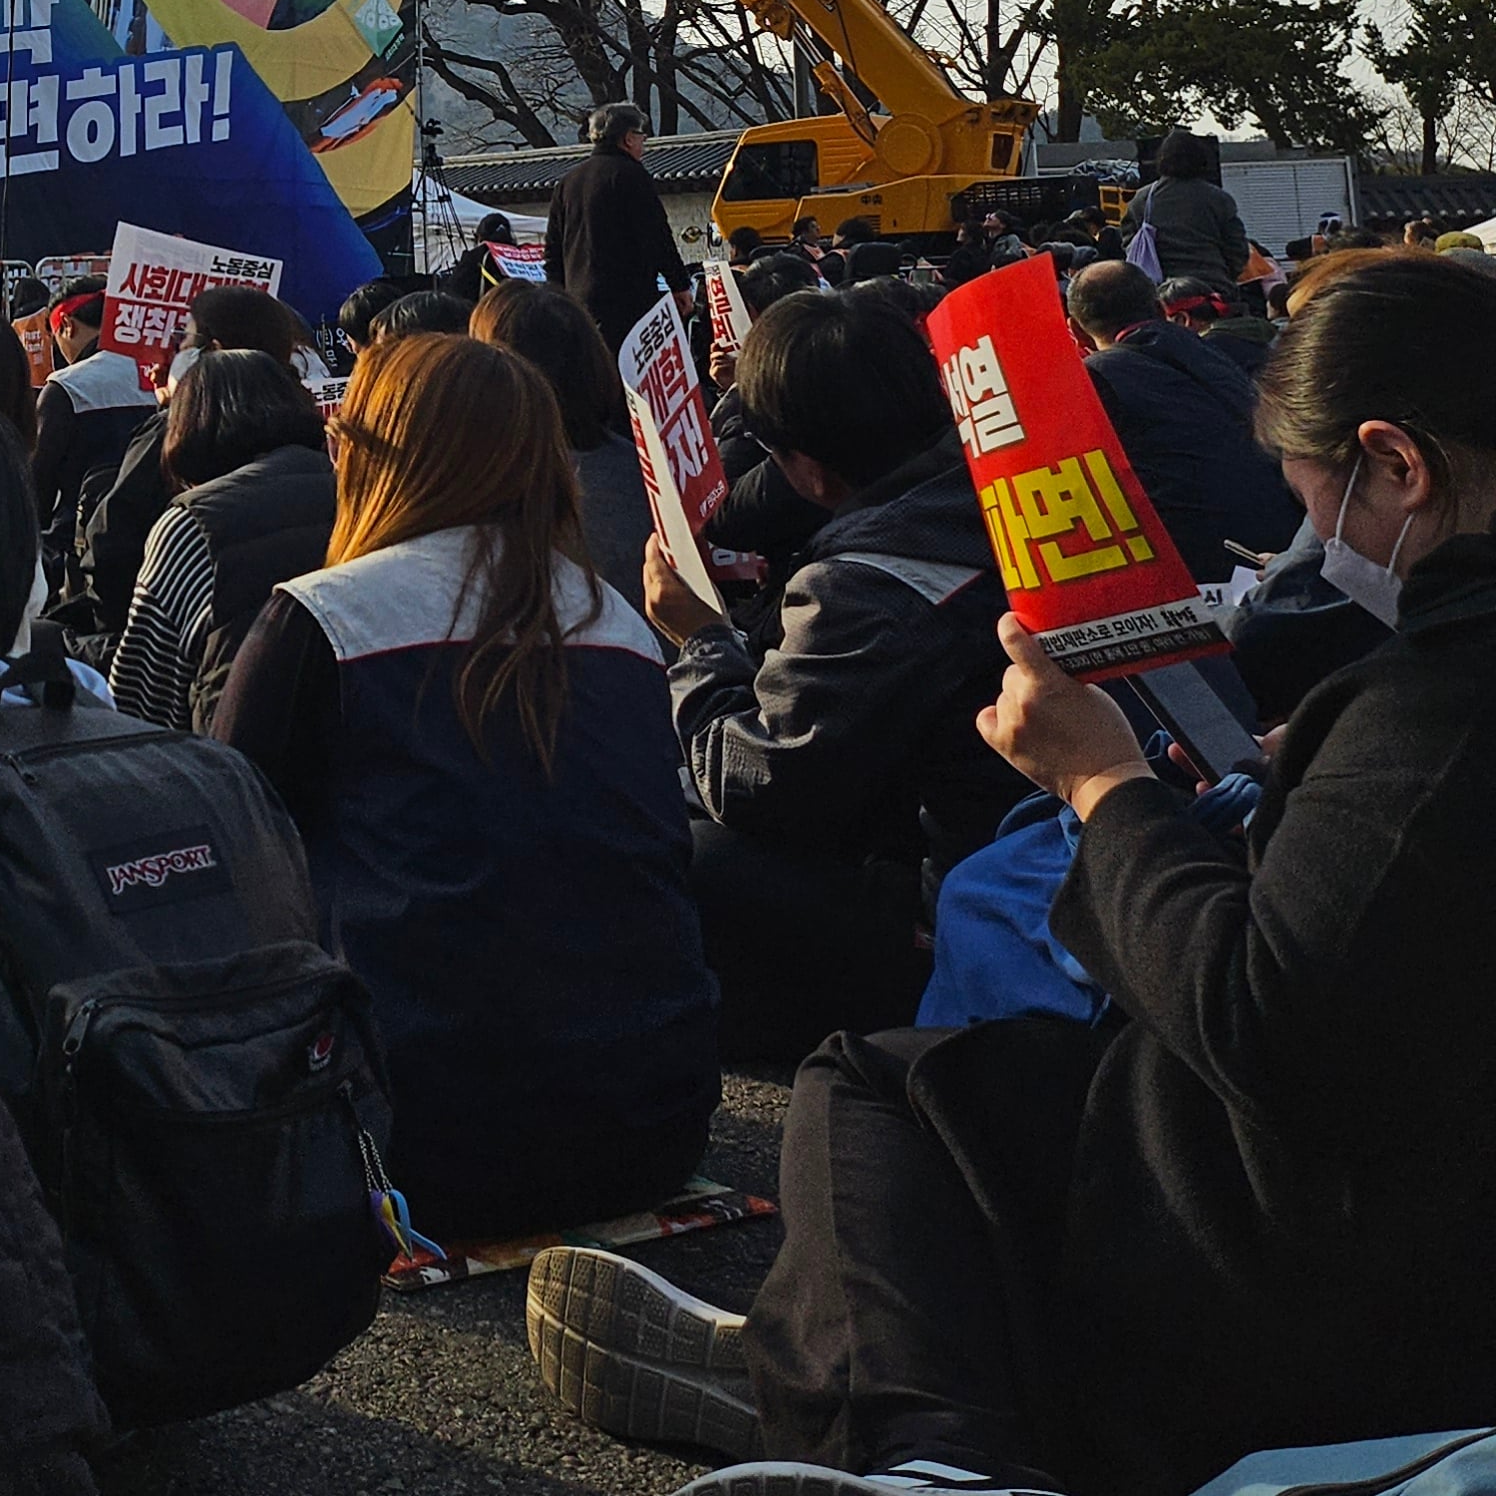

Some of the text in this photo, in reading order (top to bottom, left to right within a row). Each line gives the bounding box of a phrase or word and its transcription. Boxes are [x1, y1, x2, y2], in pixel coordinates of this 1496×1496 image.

[118, 262, 271, 305] 사회대
[210, 255, 275, 280] 노동중심
[114, 303, 192, 349] 쟁취
[1112, 613, 1158, 637] 모이자!
[106, 845, 212, 895] JANSPORT
